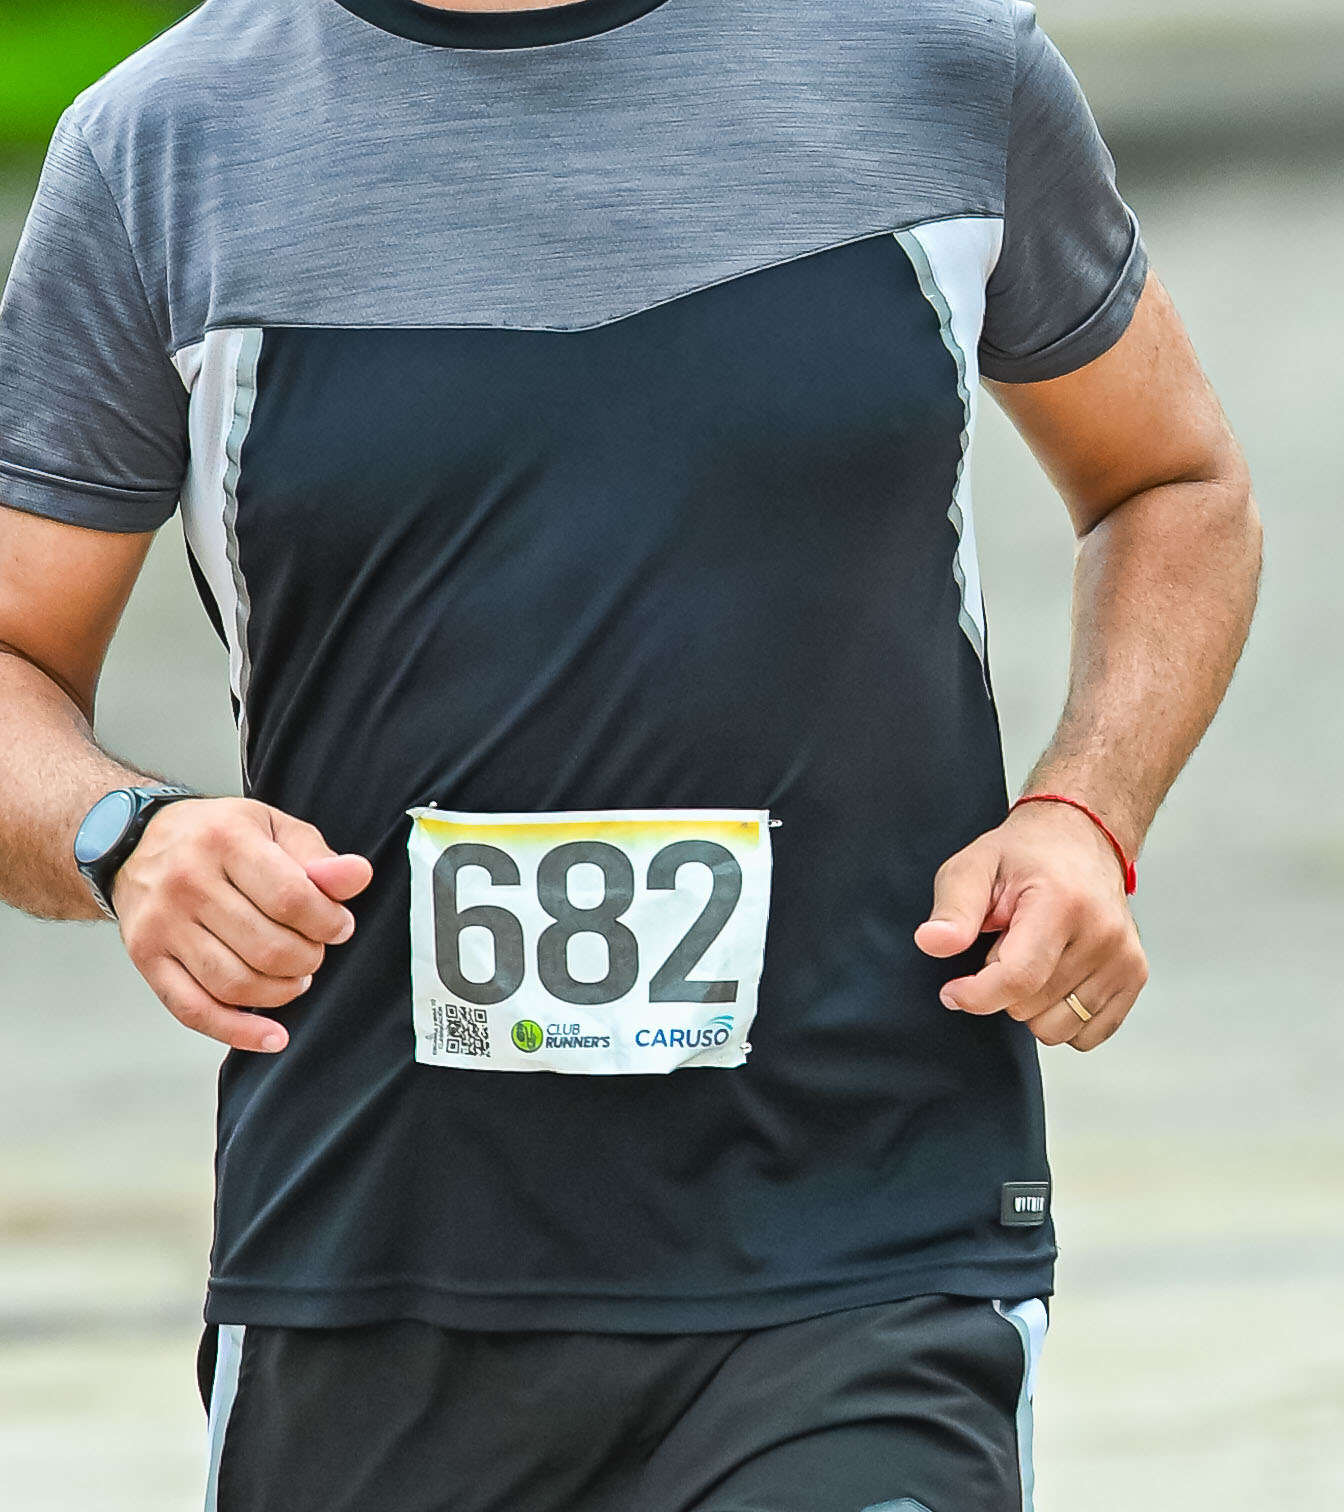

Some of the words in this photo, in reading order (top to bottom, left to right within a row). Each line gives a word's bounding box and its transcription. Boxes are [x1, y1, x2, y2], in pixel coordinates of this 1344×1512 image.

[432, 839, 743, 1006] 682
[546, 1023, 580, 1036] CLUB
[635, 1028, 730, 1049] CARUSO
